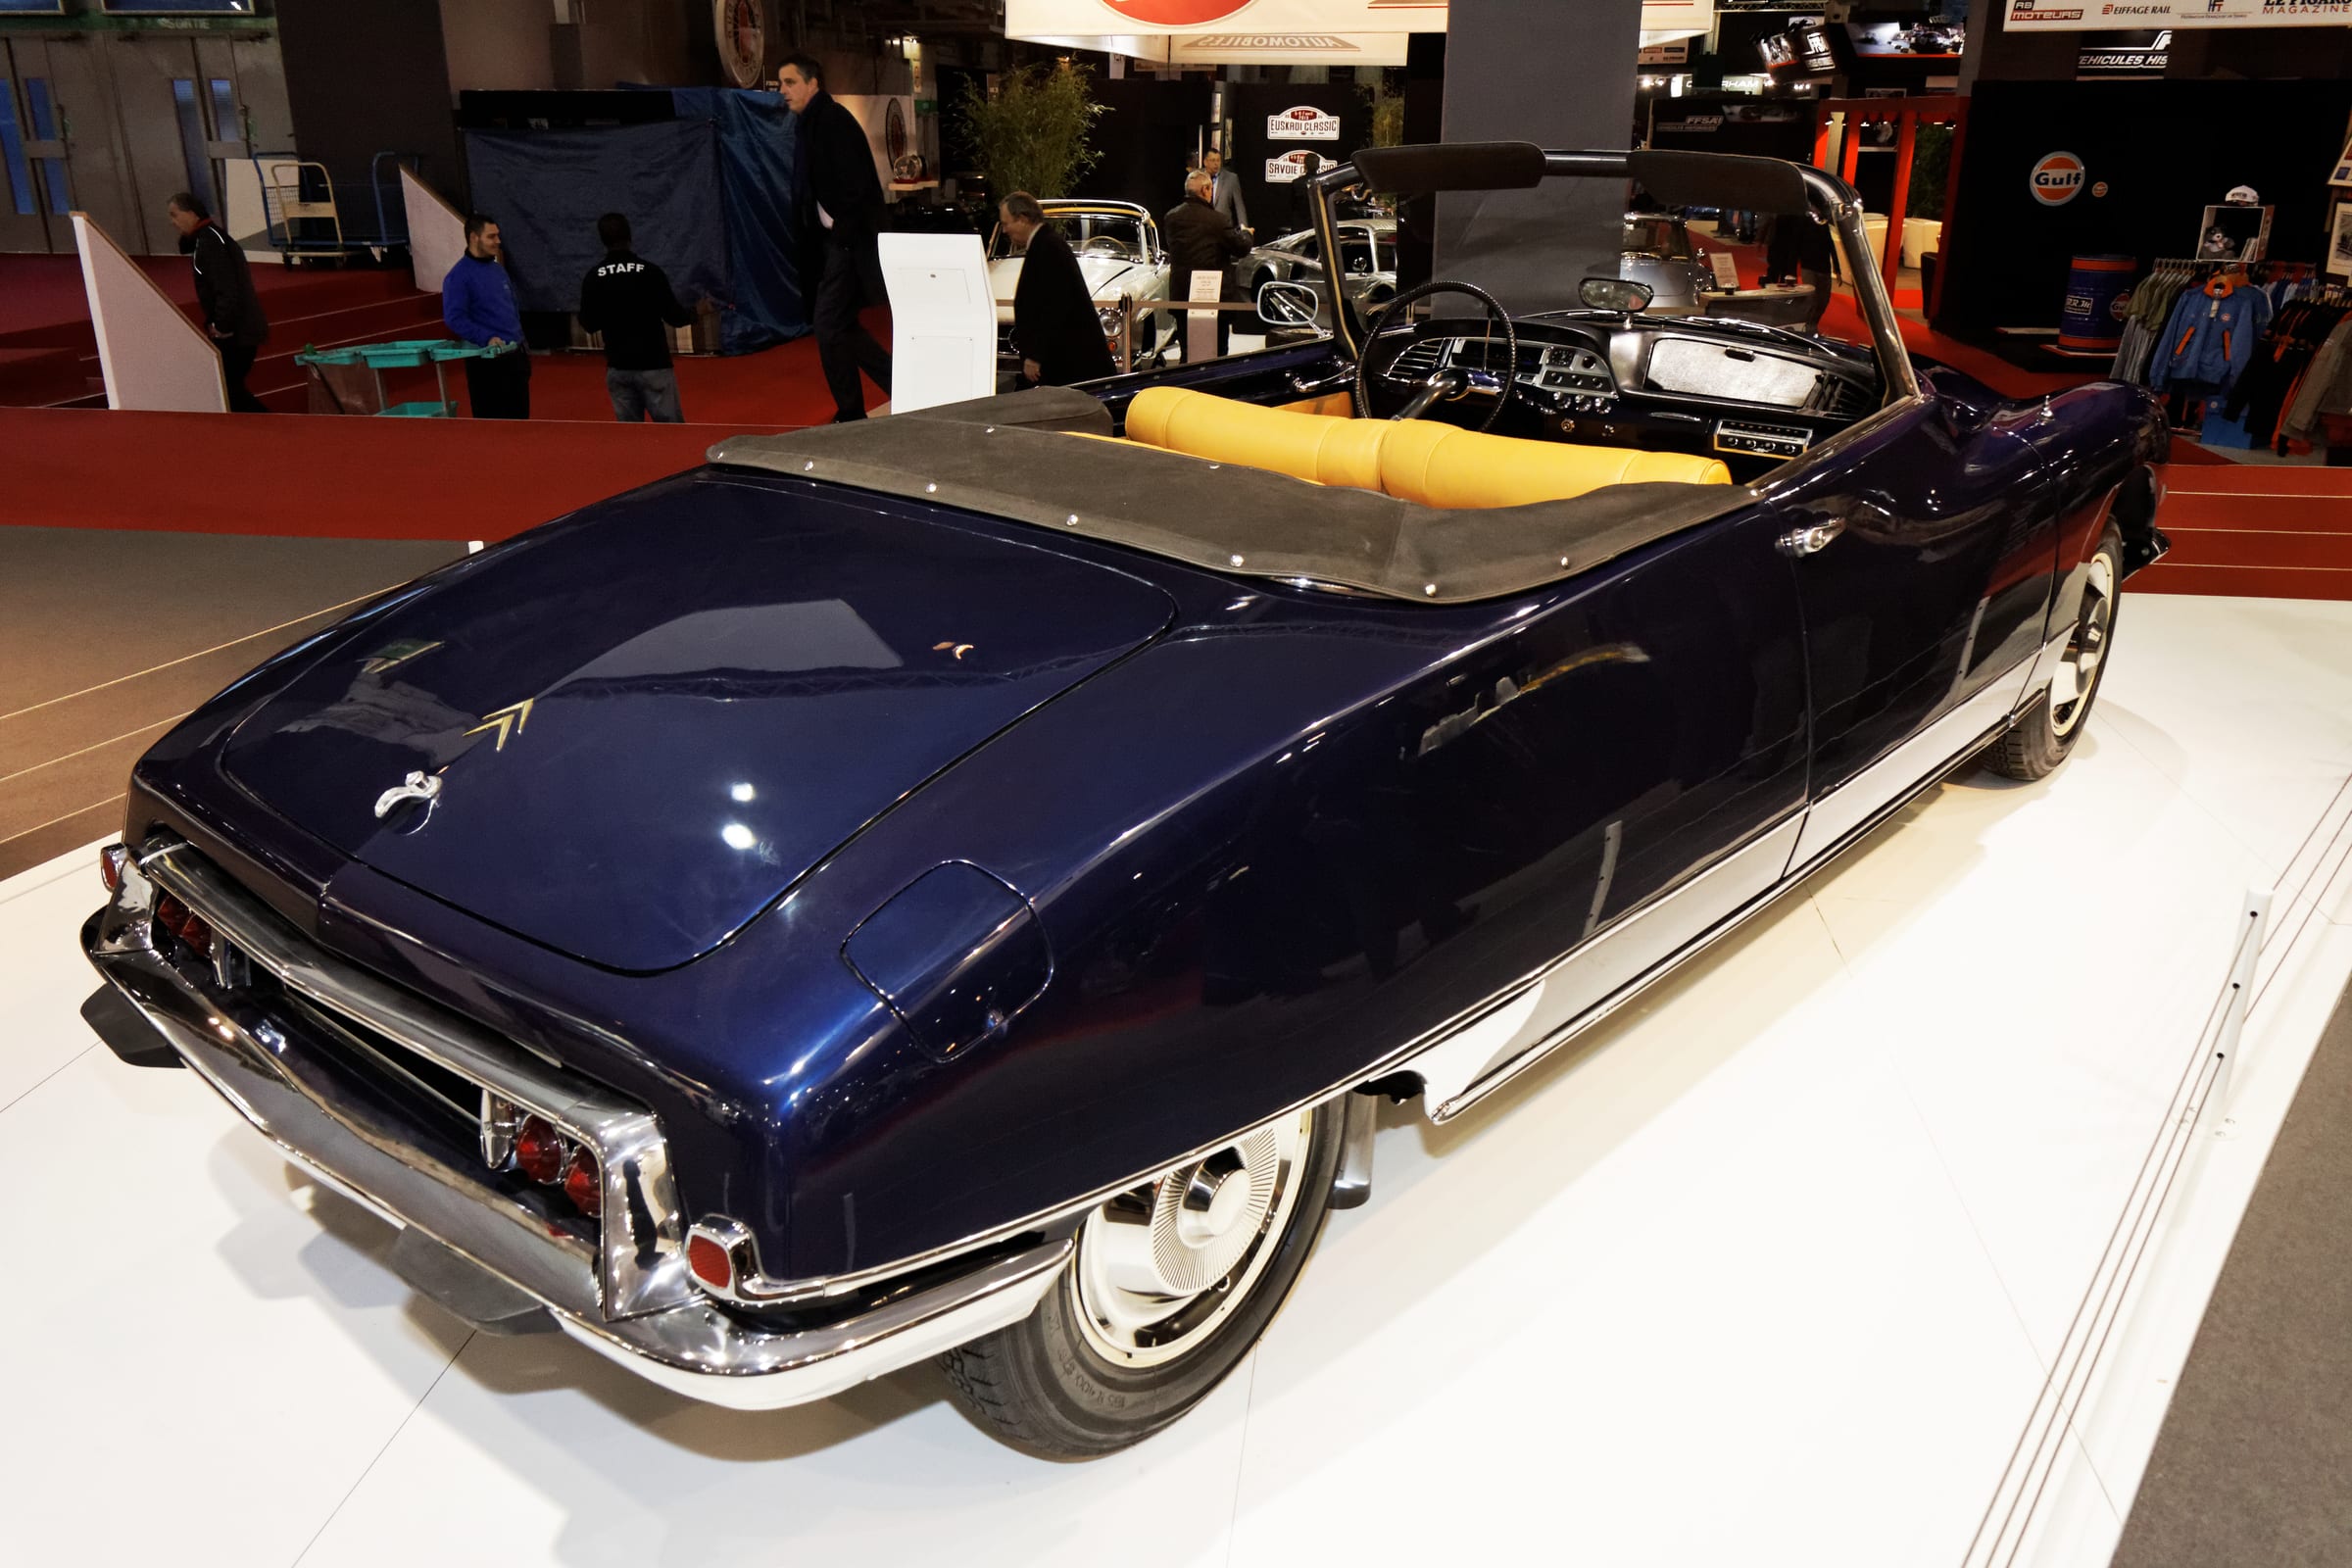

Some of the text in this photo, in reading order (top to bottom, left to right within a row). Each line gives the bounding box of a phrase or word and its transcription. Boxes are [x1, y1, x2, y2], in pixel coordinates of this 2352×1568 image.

[2113, 5, 2172, 15] EIFFAGE RAIL
[2262, 4, 2351, 15] MAGAZINE
[2078, 55, 2144, 65] EHICULES
[1270, 119, 1337, 131] EUSKADI CLASSIC
[1268, 162, 1298, 174] SAVOIE
[2034, 172, 2082, 186] Gulf
[597, 262, 645, 277] STAFF
